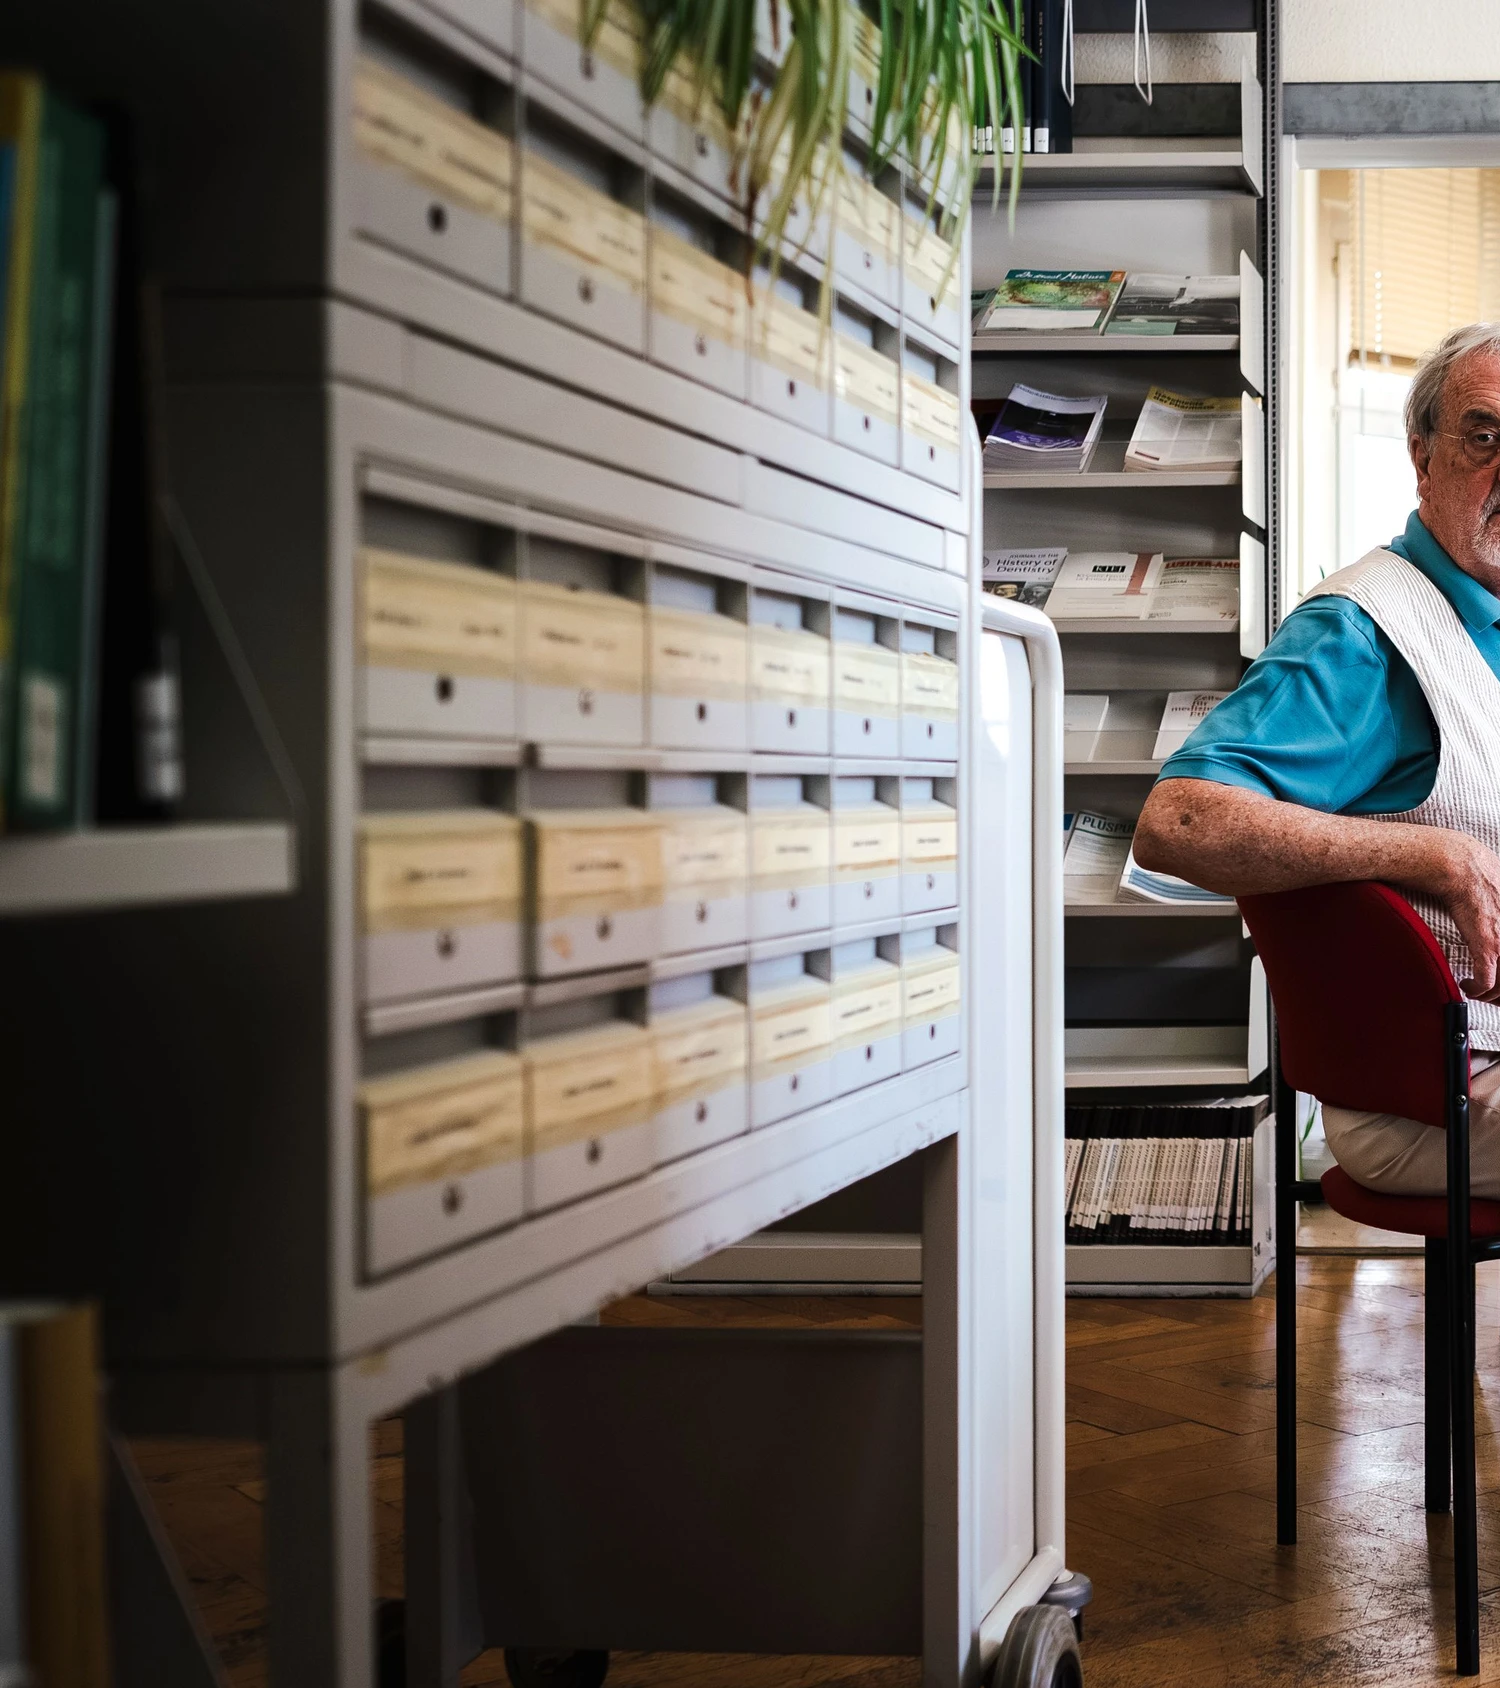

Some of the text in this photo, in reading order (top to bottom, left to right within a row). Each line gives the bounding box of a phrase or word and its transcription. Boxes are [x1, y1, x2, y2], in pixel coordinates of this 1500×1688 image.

[996, 558, 1058, 567] History of
[1164, 560, 1240, 569] LUZIFER-AMO
[996, 566, 1055, 574] Dentistry
[1082, 815, 1136, 834] PLUSPU
